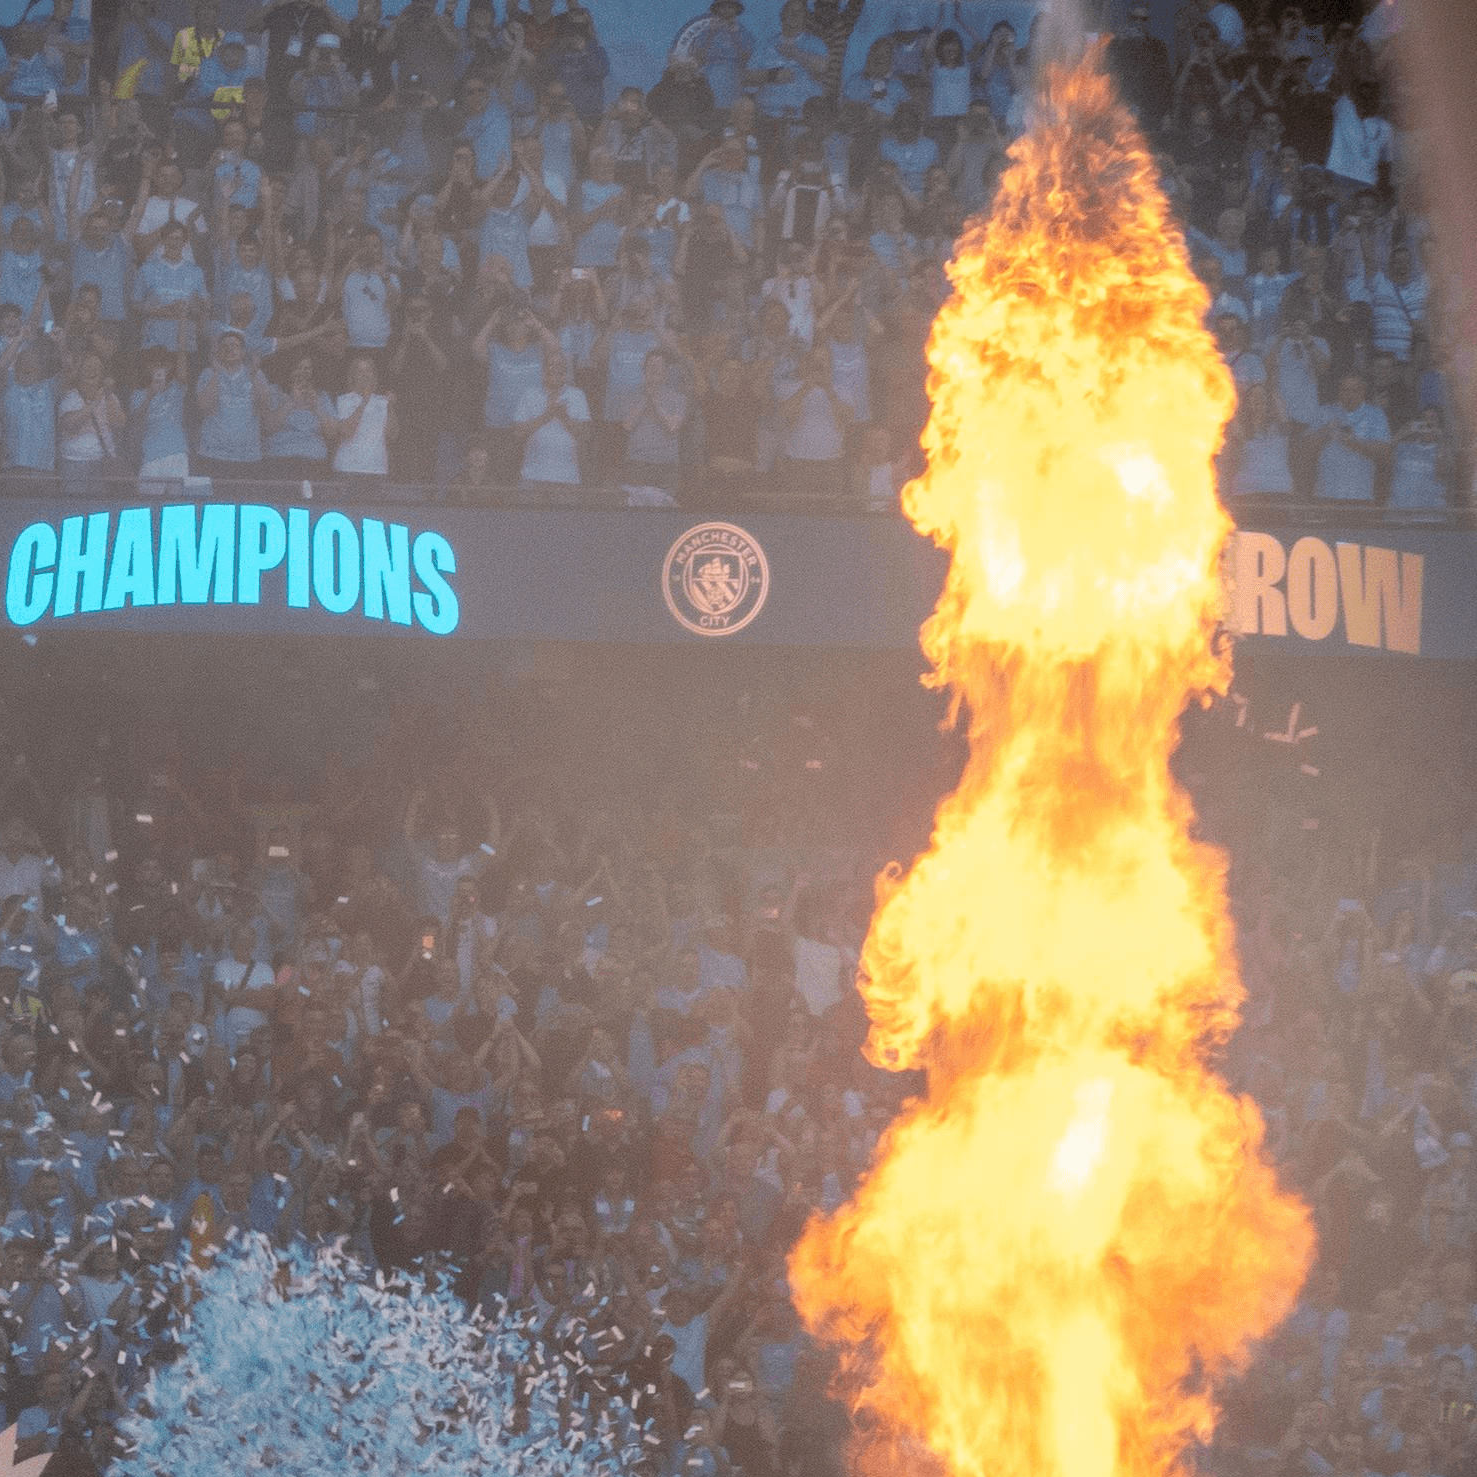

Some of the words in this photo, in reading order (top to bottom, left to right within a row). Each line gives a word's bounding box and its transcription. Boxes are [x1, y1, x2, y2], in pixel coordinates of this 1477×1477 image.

[676, 531, 758, 565] MANCHESTER
[4, 504, 460, 635] CHAMPIONS
[699, 615, 731, 627] CITY
